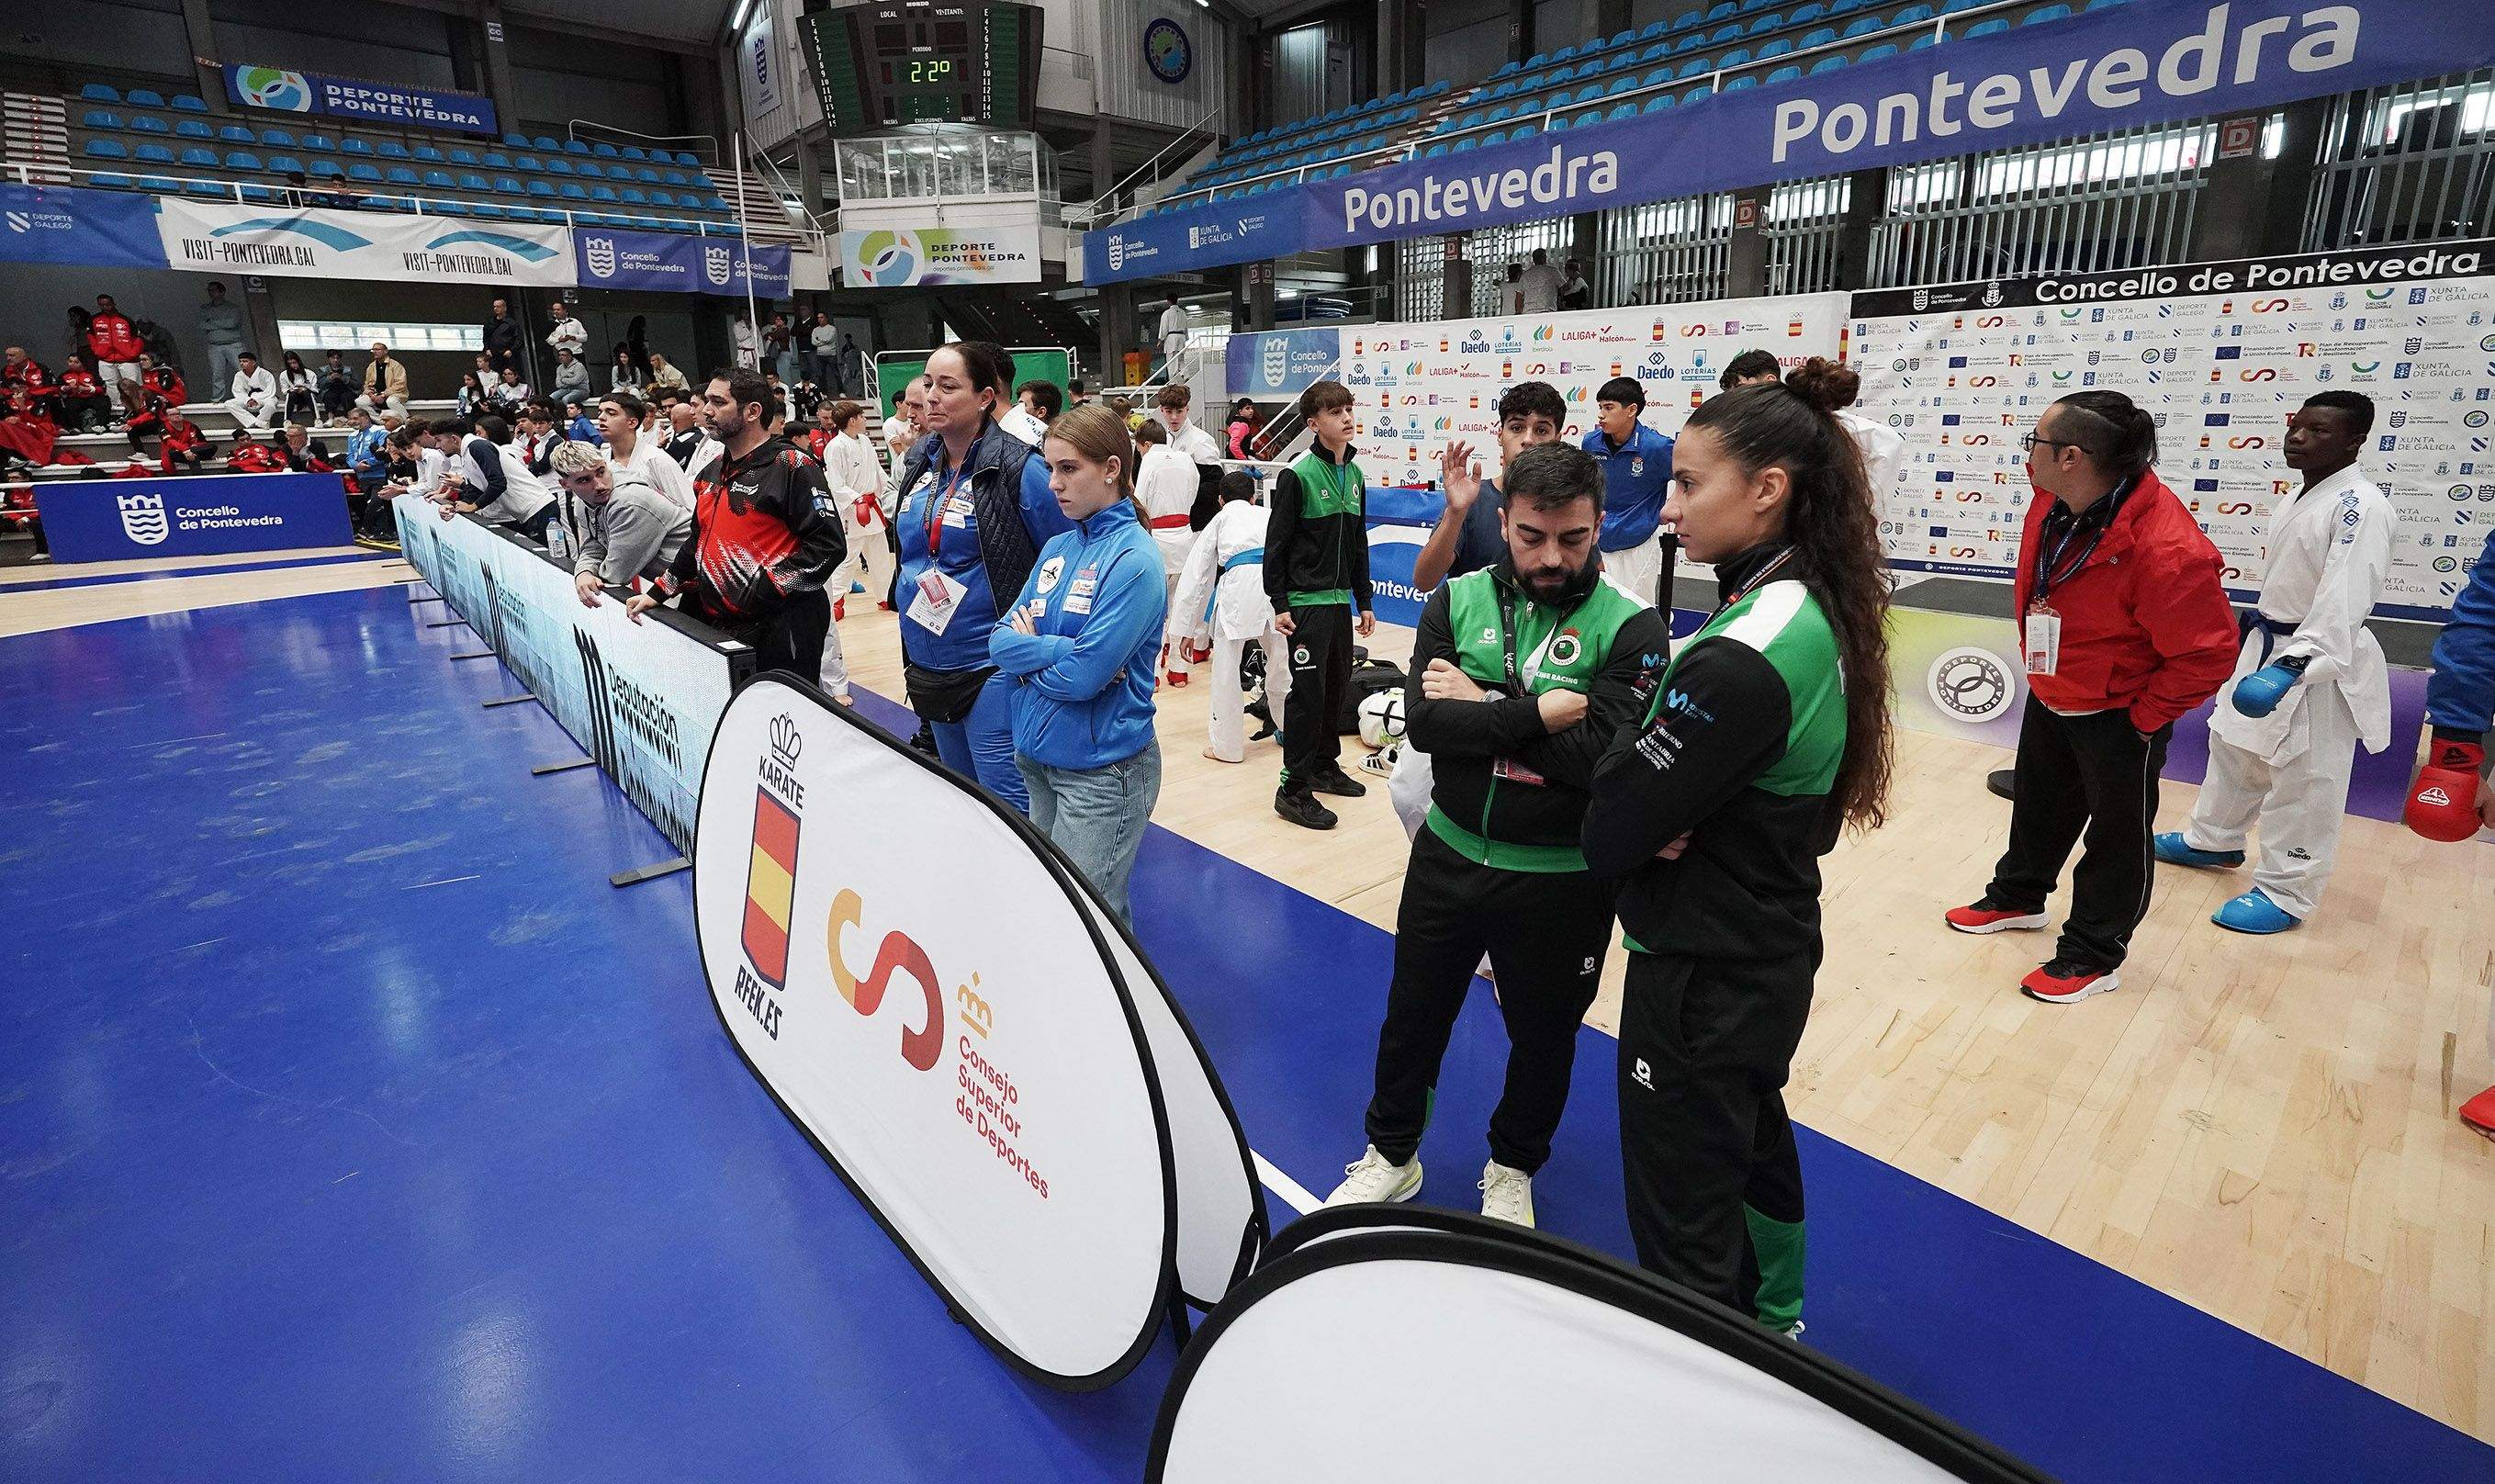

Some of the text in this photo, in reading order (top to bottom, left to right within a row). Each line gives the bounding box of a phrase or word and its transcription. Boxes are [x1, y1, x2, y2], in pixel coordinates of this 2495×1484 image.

[984, 61, 989, 69] 9
[1771, 3, 2361, 163] Pontevedra
[326, 84, 434, 107] DEPORTE
[328, 97, 480, 125] PONTEVEDRA
[2228, 129, 2250, 147] D
[1344, 144, 1618, 232] Pontevedra
[32, 213, 73, 222] DEPORTE
[1740, 206, 1752, 220] D
[35, 220, 73, 230] GALEGO
[1199, 225, 1220, 235] XUNTA
[1200, 231, 1232, 244] DE GALICIA
[183, 239, 317, 266] VISIT-PONTEVEDRA.GAL
[931, 243, 995, 253] DEPORTE
[1447, 241, 1455, 253] D
[621, 251, 659, 263] Concello
[932, 253, 1026, 263] PONTEVEDRA
[402, 252, 513, 276] VISIT-PONTEVEDRA.GAL
[623, 262, 685, 273] de Pontevedra
[735, 260, 768, 272] Cocello
[735, 269, 789, 281] de ontevedra
[2036, 250, 2481, 302] Concello de Pontevedra
[2446, 292, 2489, 301] GALICIA
[1562, 331, 1597, 341] LALIGA+
[1600, 334, 1624, 343] Halcón
[1461, 341, 1489, 354] Daedo
[1495, 340, 1523, 348] LOTERÍAS
[1291, 351, 1327, 360] Concello
[1777, 356, 1808, 367] ALIGA
[1292, 364, 1301, 373] de
[1430, 366, 1458, 377] LALIGA+
[1460, 370, 1479, 378] Halcón
[1637, 365, 1674, 379] Daedo
[1680, 366, 1716, 375] LOTERÍAS
[1348, 373, 1371, 386] Daedo
[1374, 426, 1398, 438] Daedo
[1459, 423, 1488, 432] LALIGA+
[176, 505, 240, 517] Concello
[179, 515, 283, 530] de Pontevedra
[2399, 515, 2441, 523] GALICIA
[2386, 585, 2426, 593] GALICIA
[1945, 657, 2000, 678] DEPORTE
[1551, 674, 1579, 685] RACING
[1939, 681, 2003, 714] PONTEVEDRA
[759, 755, 804, 810] KARATE
[2287, 851, 2311, 861] Daedo
[735, 964, 783, 1041] RFEK.ES
[959, 1035, 1019, 1106] Consejo
[958, 1064, 1022, 1139] Superior
[956, 1095, 1050, 1200] de Deportes
